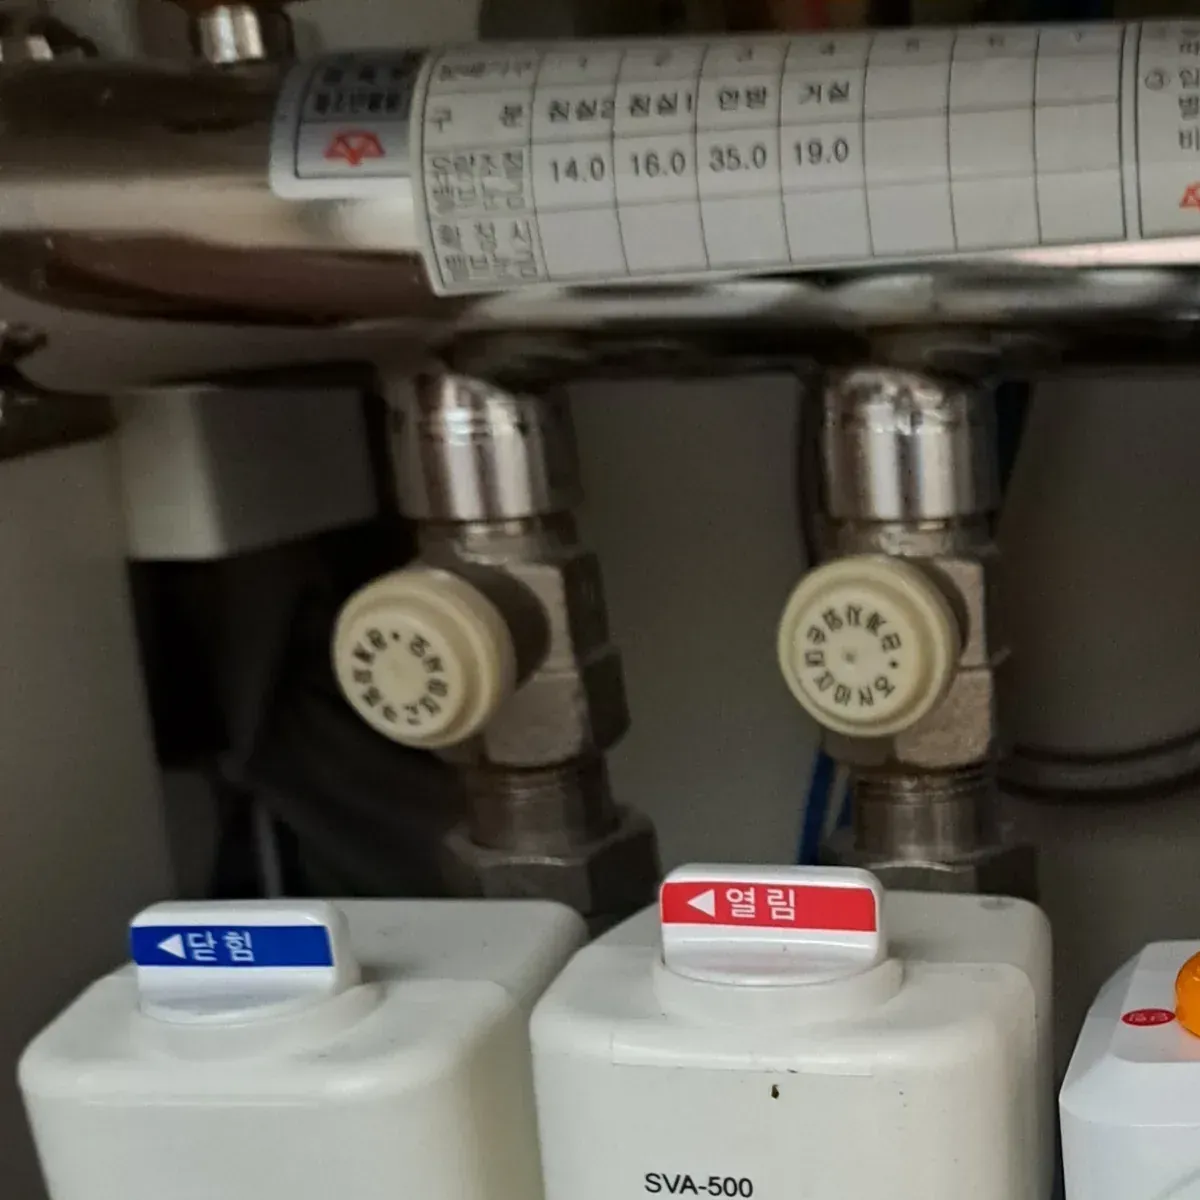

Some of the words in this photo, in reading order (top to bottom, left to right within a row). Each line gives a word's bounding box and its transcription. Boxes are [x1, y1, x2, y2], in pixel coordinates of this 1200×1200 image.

[551, 157, 605, 183] 14.0
[630, 151, 686, 178] 16.0
[709, 145, 767, 173] 35.0
[795, 138, 849, 167] 19.0
[726, 886, 795, 921] 열림
[187, 930, 255, 962] 닫힘
[645, 1172, 754, 1198] SVA-500
